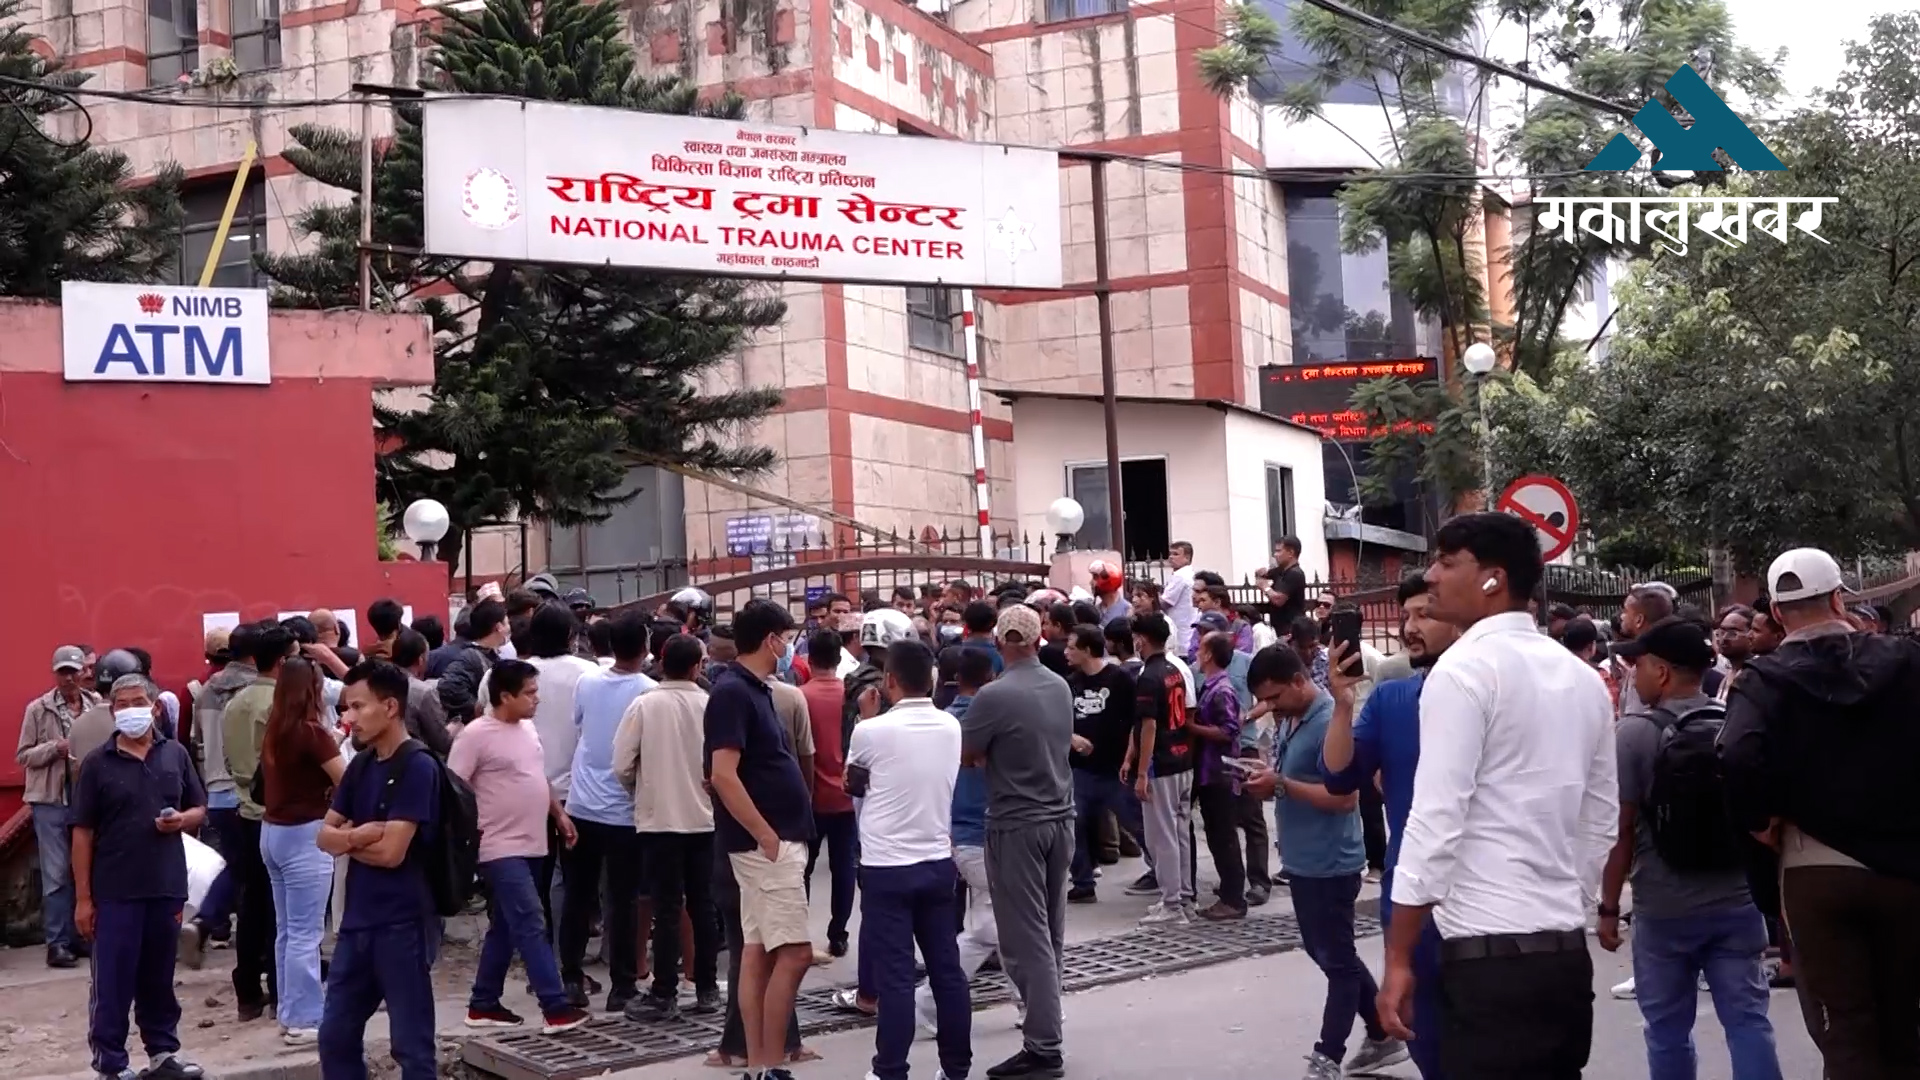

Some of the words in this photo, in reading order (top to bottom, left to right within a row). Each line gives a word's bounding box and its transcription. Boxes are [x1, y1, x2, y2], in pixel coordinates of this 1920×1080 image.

[683, 141, 723, 155] स्वास्थ्य
[726, 145, 747, 158] तथा
[736, 129, 762, 142] नेपाल
[764, 133, 797, 146] सरकार
[651, 153, 713, 176] चिकित्सा
[719, 159, 762, 179] विज्ञान
[819, 169, 876, 189] प्रतिष्ठान
[546, 173, 716, 214] राष्ट्रिय
[733, 191, 822, 220] ट्रमा
[837, 193, 967, 230] सेन्टर
[550, 215, 709, 244] NATIONAL
[718, 226, 844, 252] TRAUMA
[852, 235, 964, 260] CENTER
[173, 295, 243, 318] NIMB
[93, 323, 243, 376] ATM
